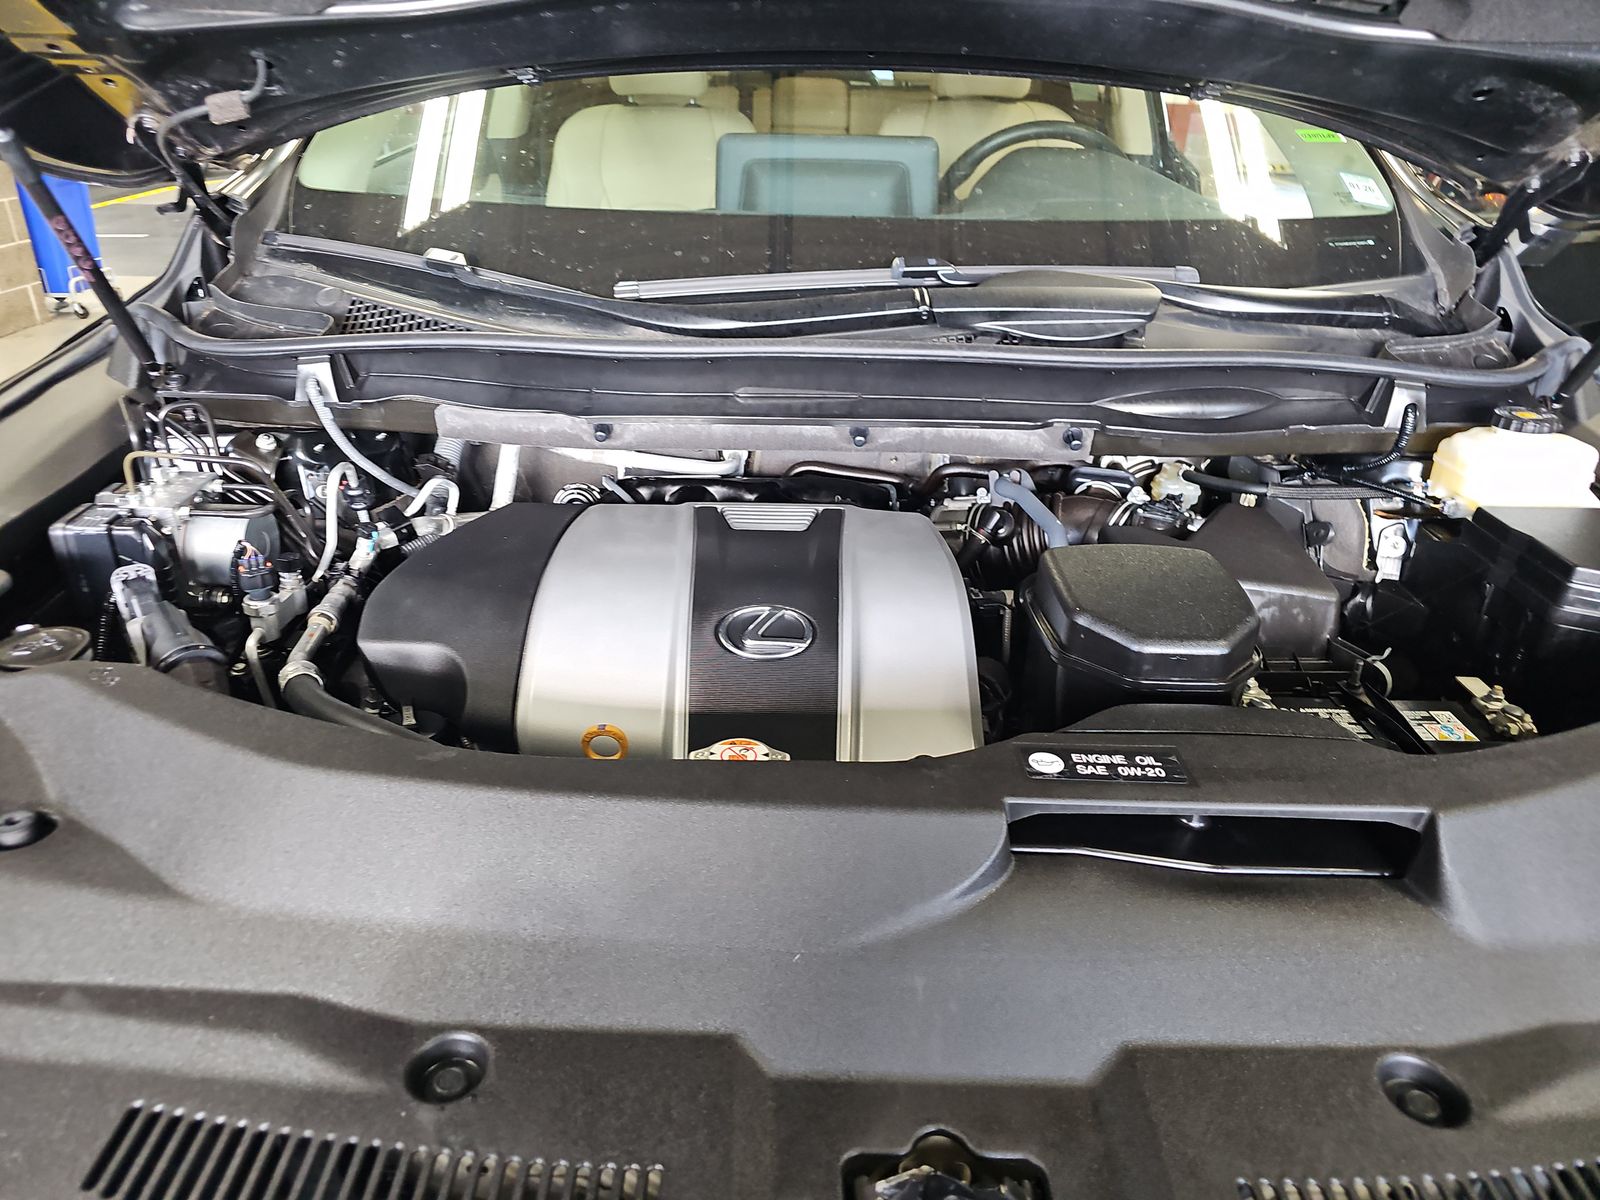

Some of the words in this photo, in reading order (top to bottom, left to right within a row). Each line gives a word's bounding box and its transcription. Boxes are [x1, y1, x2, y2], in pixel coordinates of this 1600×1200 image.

[1070, 753, 1128, 765] ENGINE
[1135, 755, 1163, 766] OIL
[1076, 765, 1110, 776] SAE
[1117, 766, 1166, 778] 0W-20
